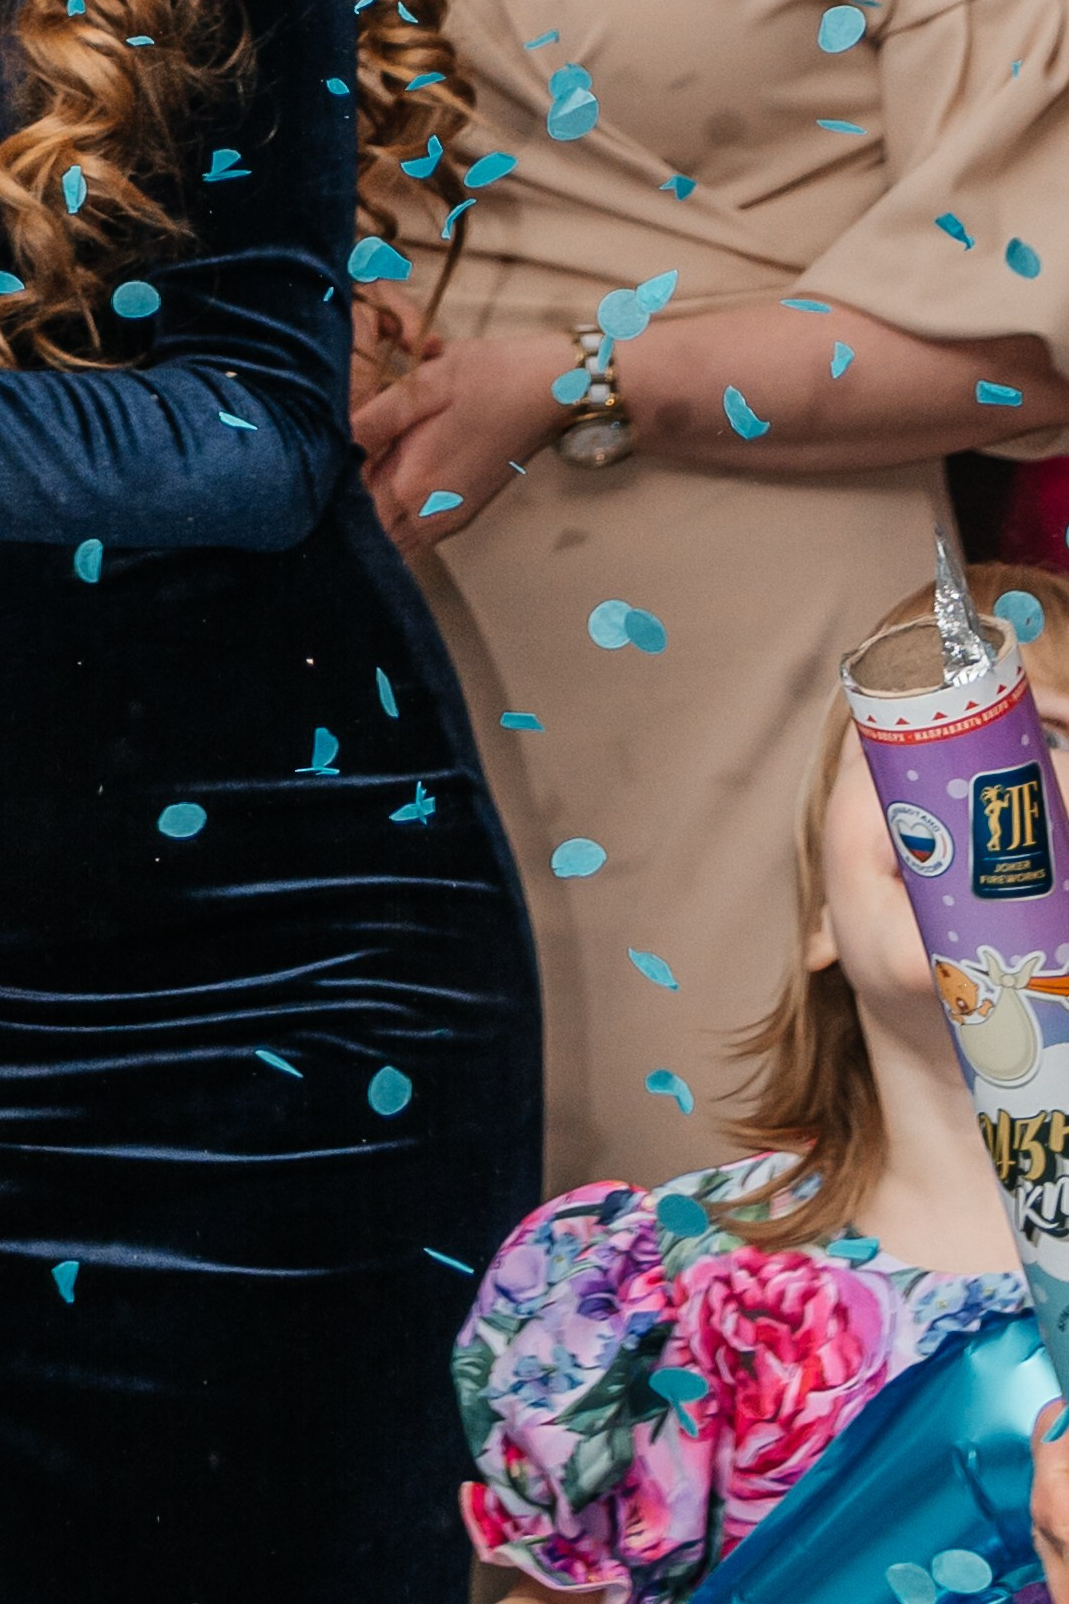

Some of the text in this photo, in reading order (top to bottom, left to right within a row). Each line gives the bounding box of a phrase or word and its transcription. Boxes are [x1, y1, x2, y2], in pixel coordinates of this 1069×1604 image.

[1005, 780, 1039, 851] JF
[994, 860, 1031, 873] JOKER
[979, 868, 1046, 885] FIREWORKS
